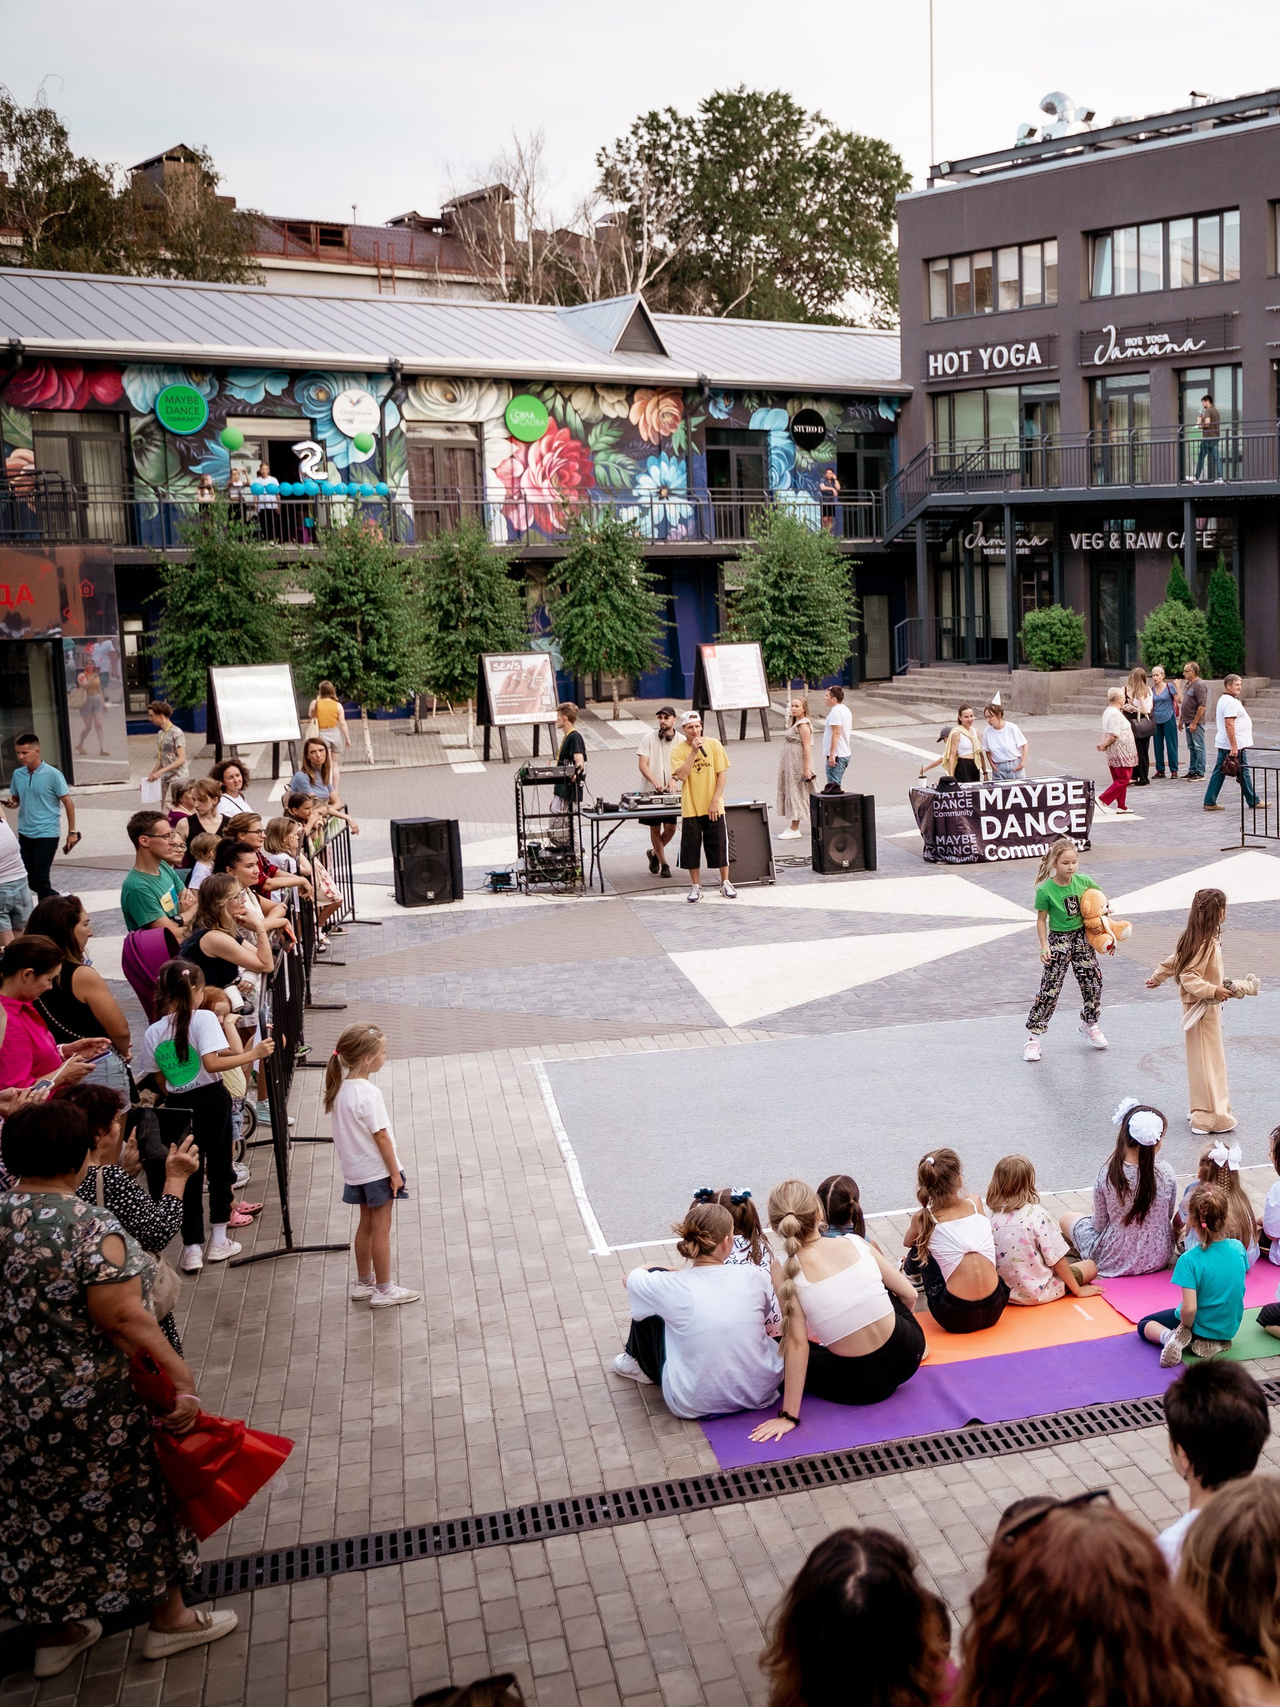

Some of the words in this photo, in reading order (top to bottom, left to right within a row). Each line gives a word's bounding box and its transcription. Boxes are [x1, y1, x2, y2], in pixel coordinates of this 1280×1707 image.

[1094, 324, 1206, 366] Jamuna
[1125, 337, 1144, 347] HOT
[1145, 334, 1170, 344] YOGA
[929, 350, 972, 376] HOT
[979, 341, 1042, 370] YOGA
[165, 395, 200, 405] MAYBE
[165, 406, 201, 416] DANCE
[793, 424, 817, 434] STUDIO
[292, 440, 328, 480] 2
[964, 520, 1049, 549] Jamna
[1070, 533, 1104, 550] VEG
[1109, 533, 1120, 549] &
[1126, 532, 1163, 549] RAW
[979, 781, 1085, 811] MAYBE
[933, 798, 974, 810] DANCE
[933, 809, 974, 818] Community
[981, 809, 1087, 840] DANCE
[935, 833, 977, 846] MAYBE
[936, 844, 979, 855] DANCE
[984, 837, 1086, 861] Commty
